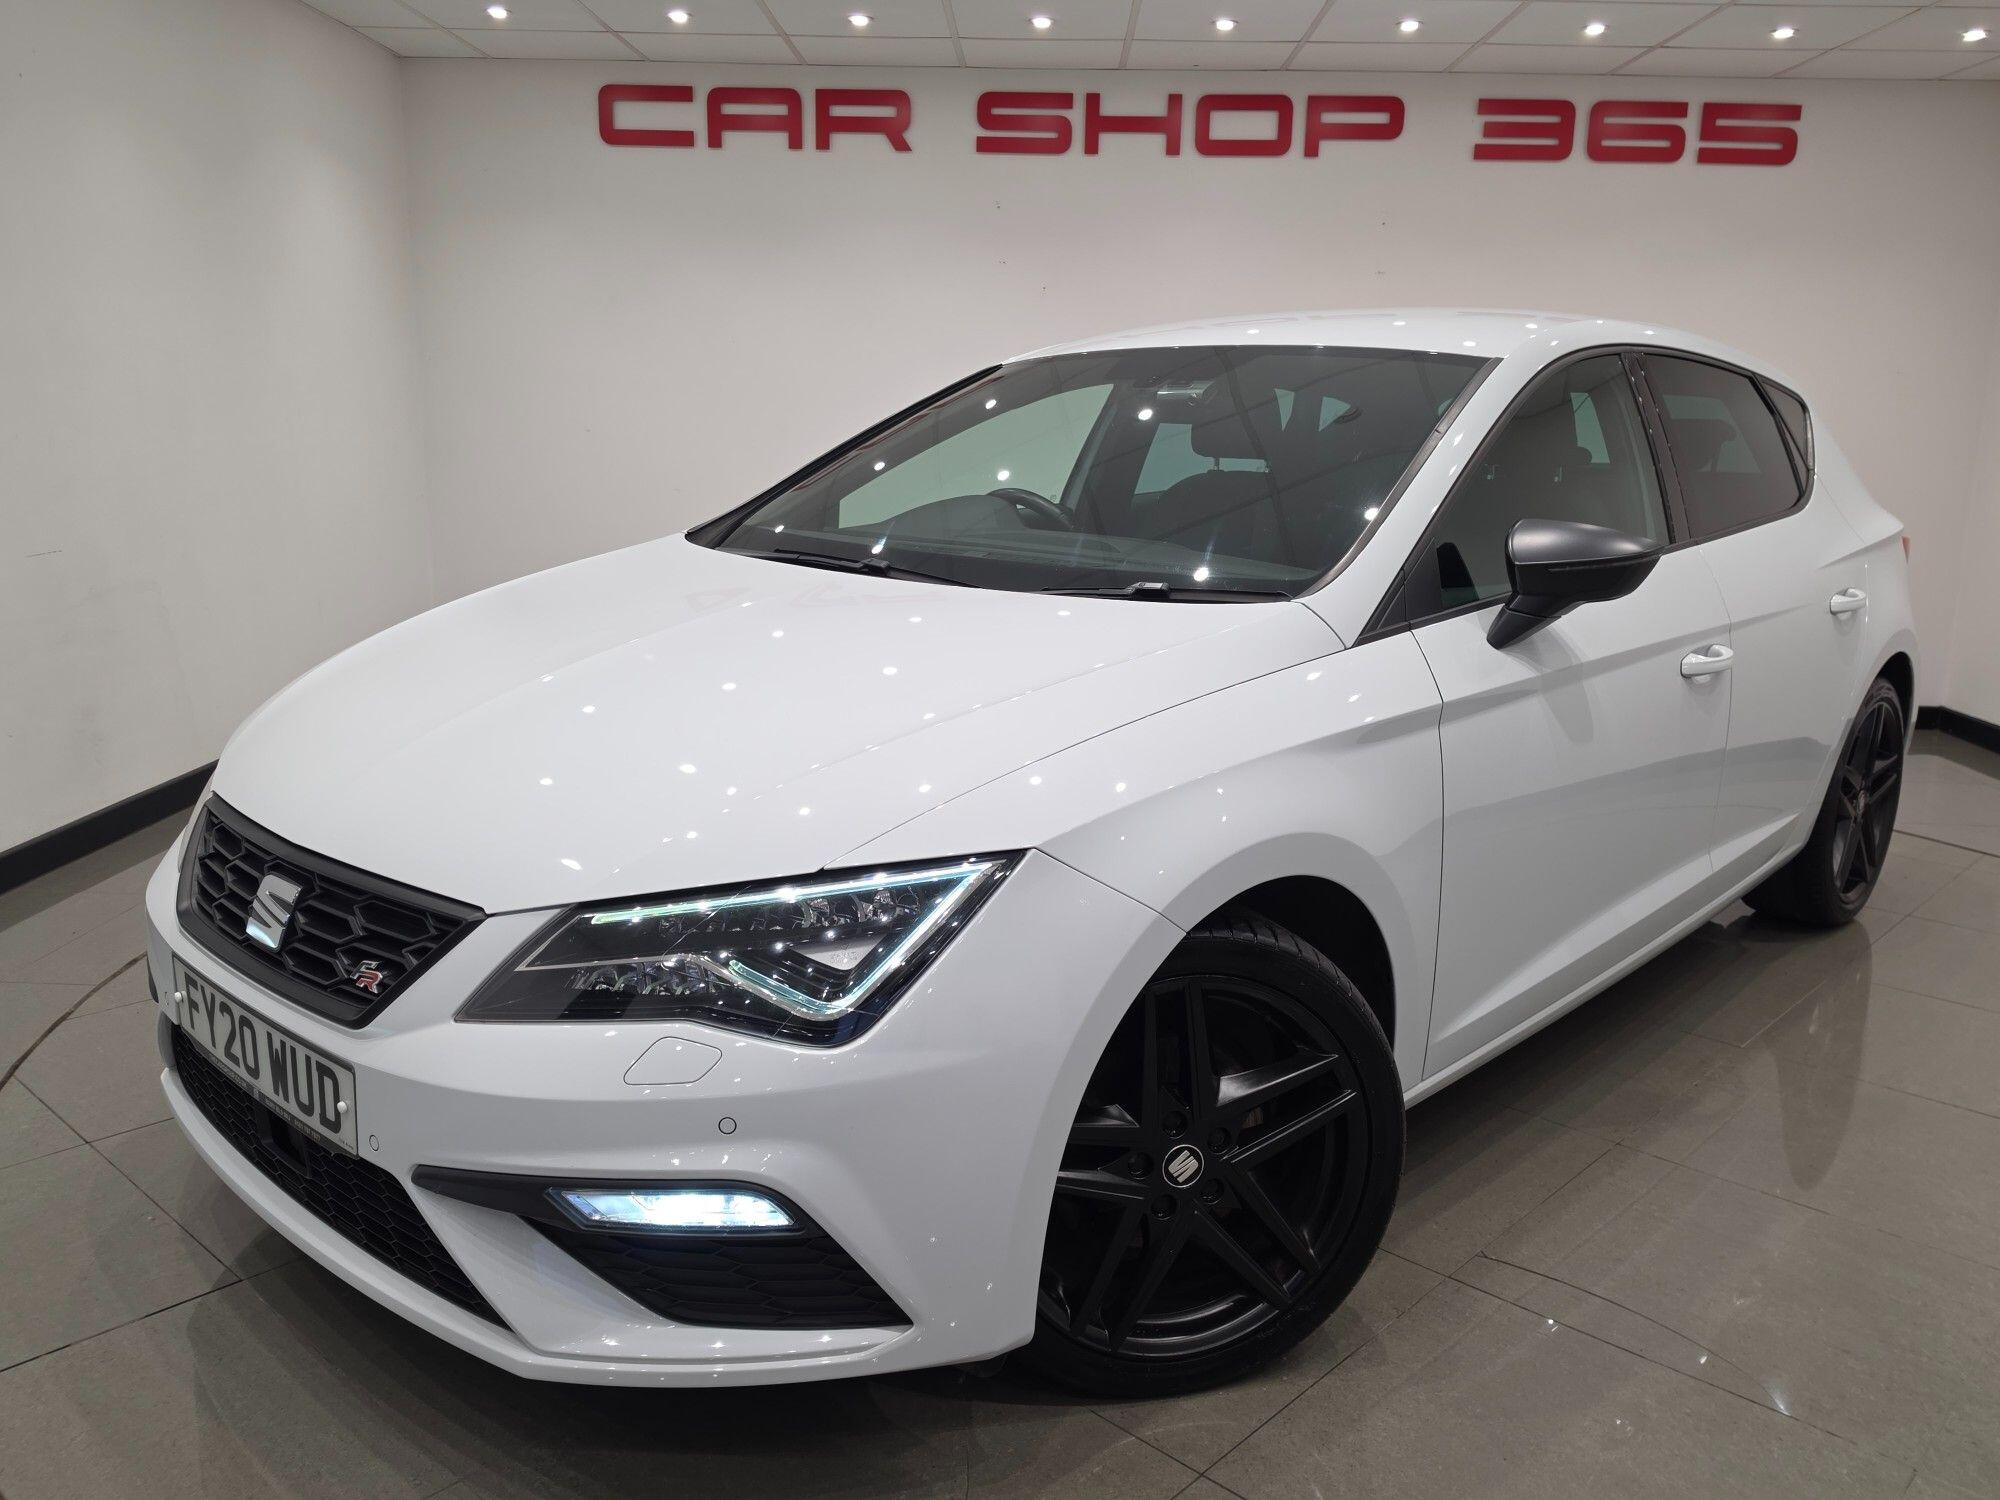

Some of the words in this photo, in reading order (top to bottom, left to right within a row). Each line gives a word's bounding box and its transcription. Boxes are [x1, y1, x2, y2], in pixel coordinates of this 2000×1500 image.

[598, 84, 912, 153] CAR
[975, 91, 1405, 158] SHOP
[1473, 99, 1802, 166] 365
[184, 971, 260, 1081] FY20
[266, 1030, 342, 1134] WUD
